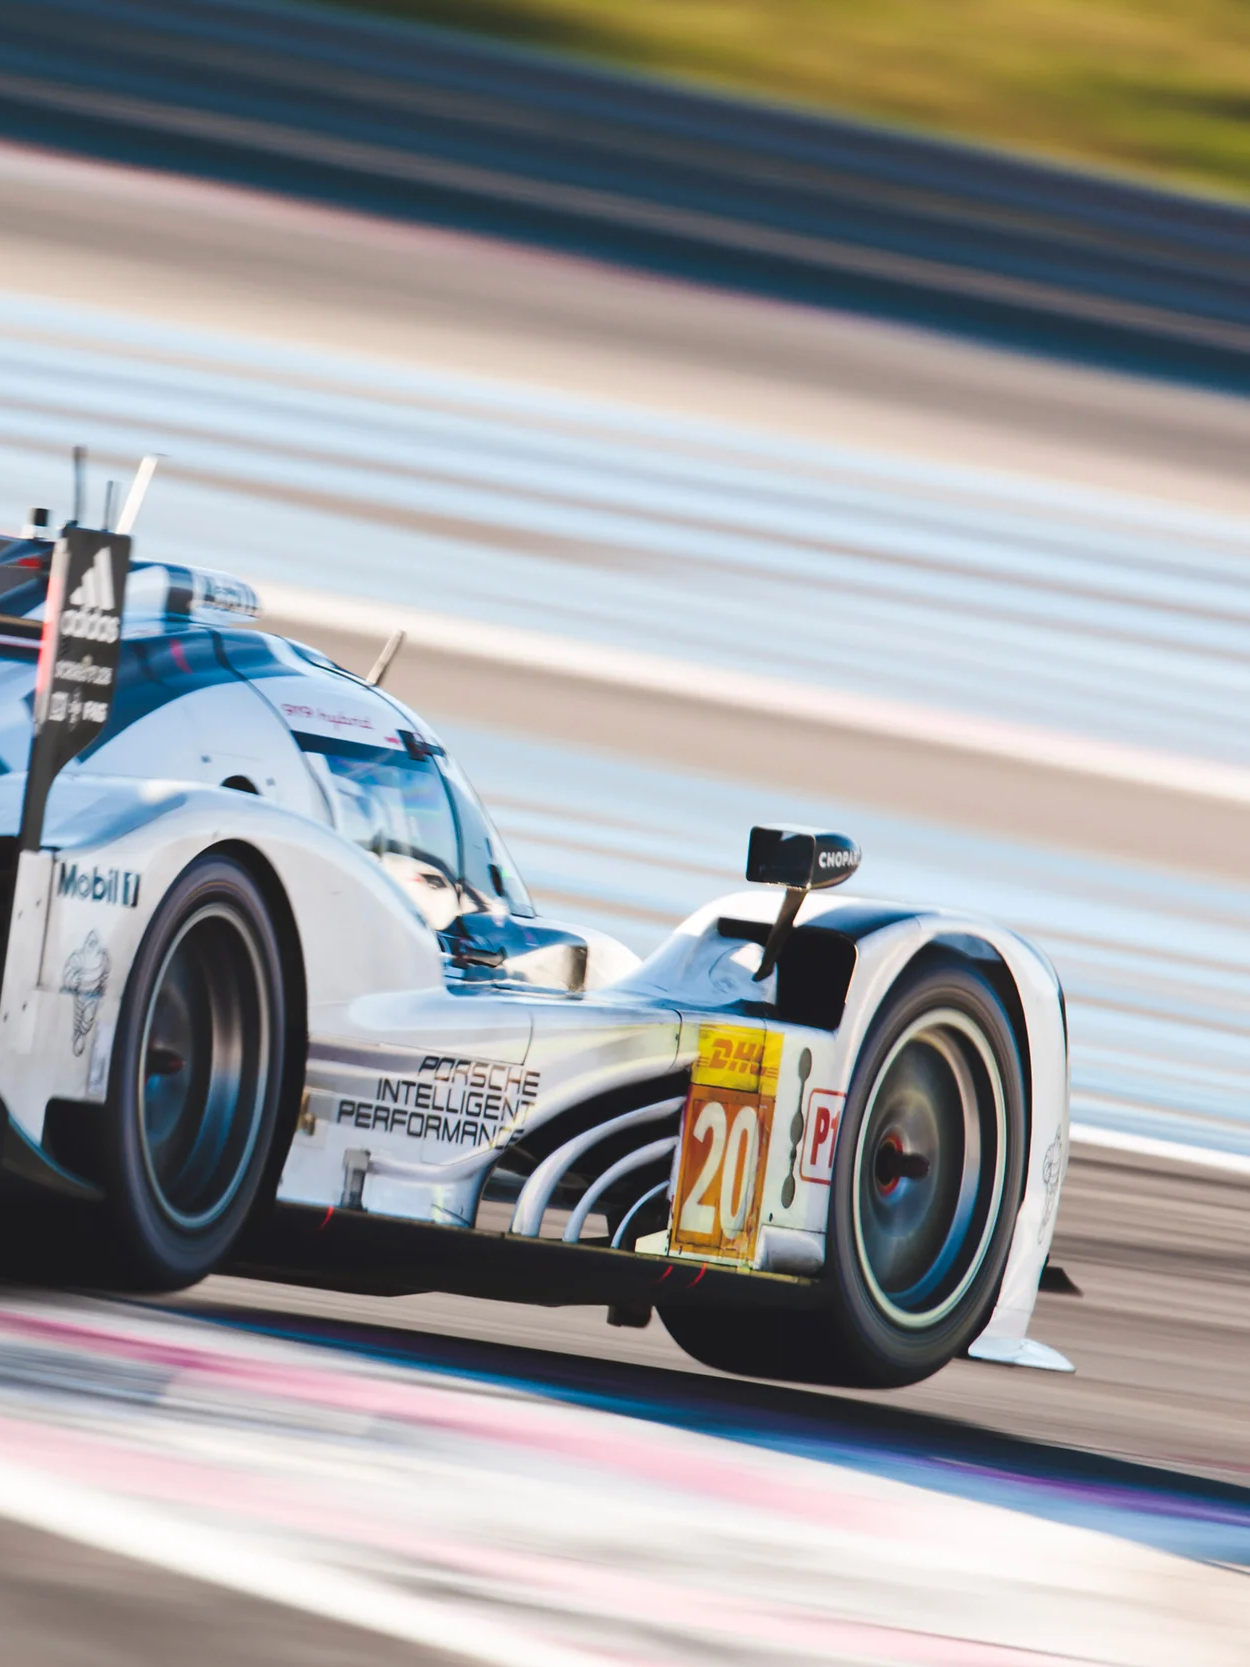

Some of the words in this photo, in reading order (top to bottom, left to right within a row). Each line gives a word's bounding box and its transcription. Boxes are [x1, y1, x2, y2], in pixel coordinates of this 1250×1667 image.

[61, 606, 120, 643] adidas
[57, 862, 119, 904] Mobil
[418, 1055, 541, 1098] PORSCHE
[709, 1038, 767, 1076] DHL
[376, 1077, 536, 1124] INTELLIGENT
[680, 1101, 760, 1240] 20
